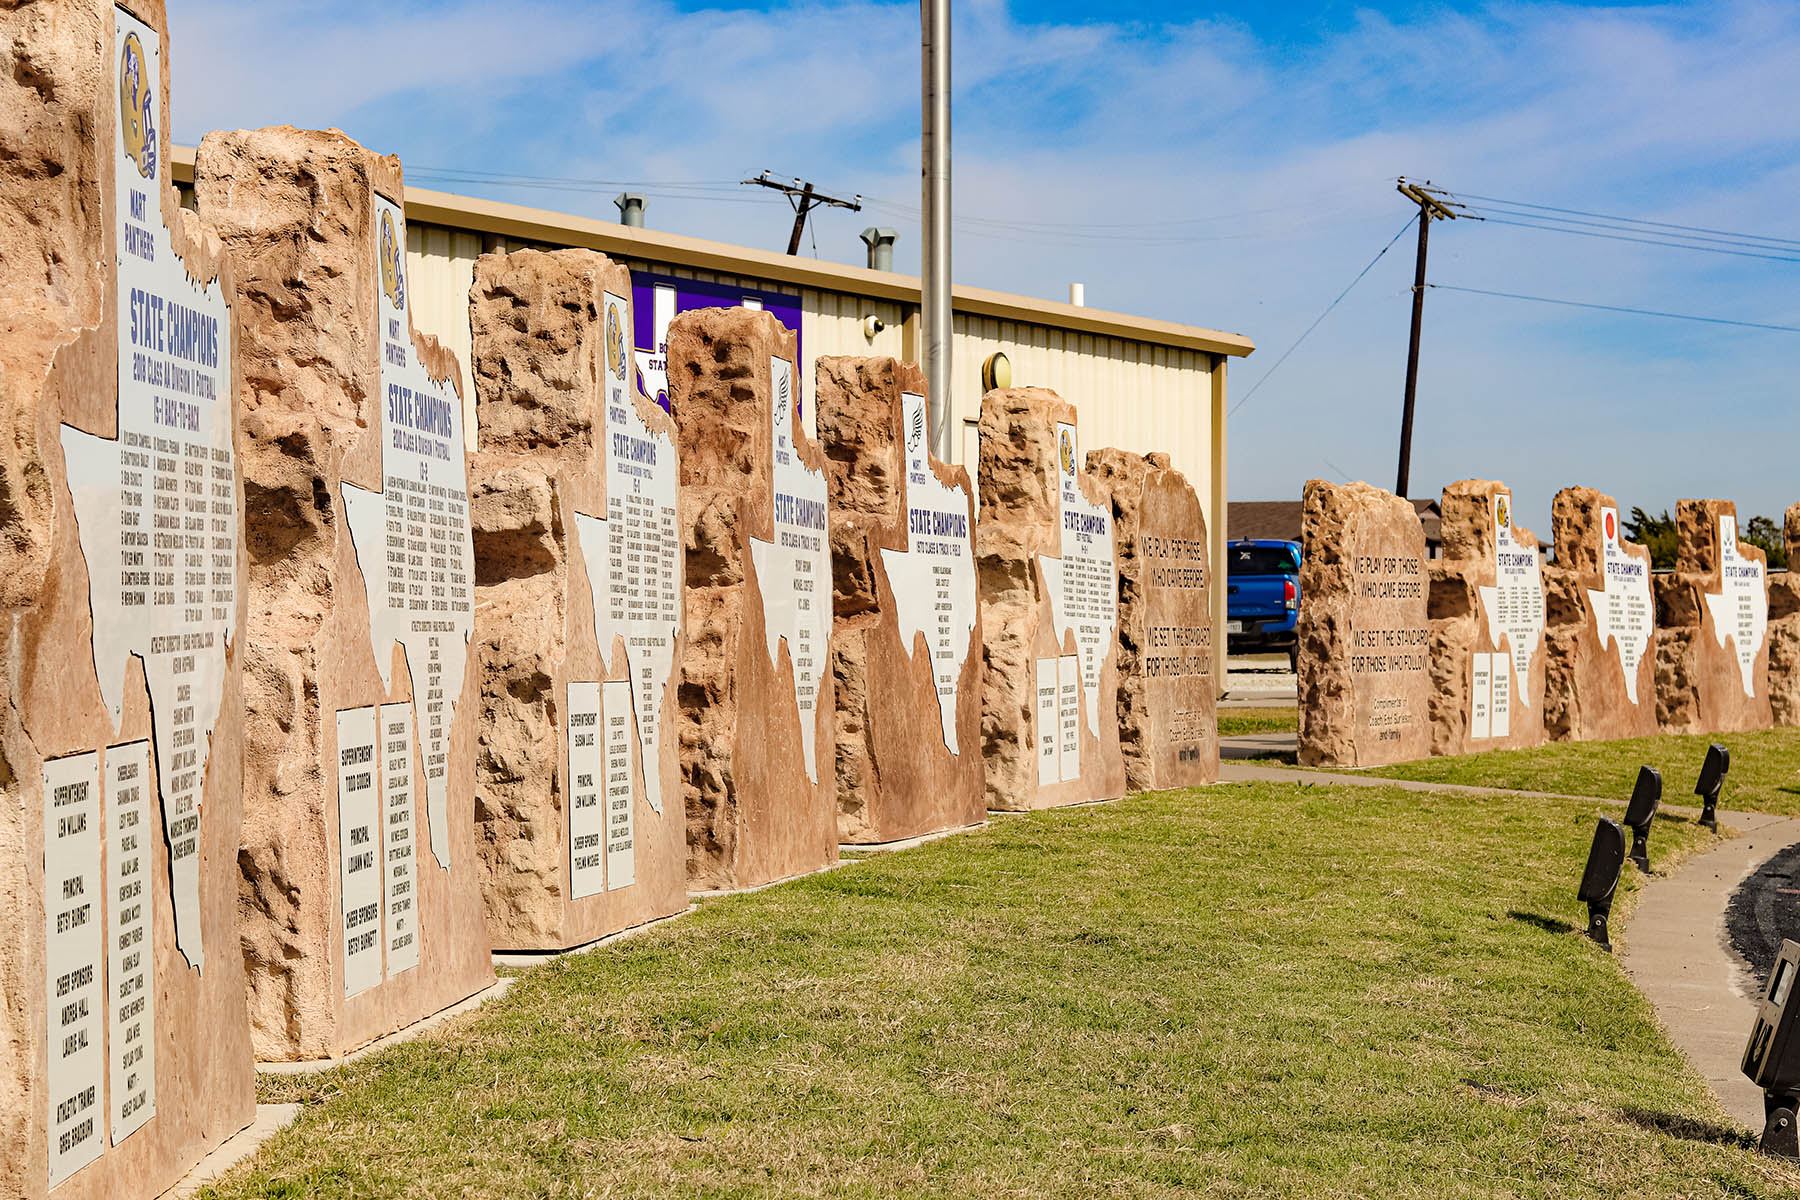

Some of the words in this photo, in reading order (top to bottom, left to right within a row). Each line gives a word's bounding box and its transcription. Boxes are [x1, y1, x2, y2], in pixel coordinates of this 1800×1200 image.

[130, 188, 147, 222] MART
[124, 223, 155, 262] PANTHERS
[131, 288, 164, 352] STATE
[168, 301, 218, 368] CHAMPIONS
[386, 342, 406, 368] PANTHERS
[133, 352, 146, 383] 2018
[147, 355, 163, 387] CLASS
[172, 360, 191, 395] DIVISION
[196, 366, 217, 400] FOOTBALL
[388, 383, 413, 428] STATE
[414, 390, 453, 438] CHAMPIONS
[403, 432, 415, 453] CLASS
[613, 432, 629, 460] STATE
[630, 437, 657, 466] CHAMPIONS
[776, 492, 794, 525] STATE
[795, 496, 826, 532] CHAMPIONS
[910, 508, 931, 535] STATE
[932, 511, 967, 539] CHAMPIONS
[1064, 510, 1080, 532] STATE
[1081, 514, 1106, 535] CHAMPIONS
[1141, 536, 1153, 557] WE
[1353, 557, 1365, 574] WE
[1366, 557, 1381, 575] PLAY
[1383, 557, 1397, 575] FOR
[1398, 557, 1419, 575] THOSE
[1498, 554, 1511, 566] STATE
[1512, 555, 1533, 568] CHAMPIONS
[1607, 562, 1620, 574] STATE
[1621, 563, 1642, 577] CHAMPIONS
[1725, 566, 1737, 577] STATE
[1738, 567, 1759, 579] CHAMPIONS
[1183, 568, 1204, 588] BEFORE
[1361, 581, 1377, 599] WHO
[1379, 582, 1396, 598] CAME
[1397, 582, 1421, 598] BEFORE
[1354, 630, 1365, 648] WE
[1367, 630, 1380, 647] SET
[1382, 630, 1395, 647] THE
[1397, 629, 1429, 646] STANDARD
[1146, 656, 1161, 677] FOR
[1352, 656, 1366, 673] FOR
[1366, 656, 1387, 673] THOSE
[1388, 655, 1403, 671] WHO
[1404, 655, 1428, 671] FOLLOW
[341, 745, 373, 766] SUPERINTENDENT
[54, 781, 89, 807] SUPERINTENDENT
[67, 812, 87, 837] WILLIAMS
[350, 825, 369, 846] PRINCIPAL
[63, 875, 84, 900] PRINCIPAL
[57, 910, 71, 934] BETSY
[72, 903, 91, 928] BURNETT
[346, 909, 358, 930] CHEER
[57, 973, 70, 998] CHEER
[71, 963, 93, 991] SPONSORS
[57, 1096, 77, 1125] ATHLETIC
[78, 1085, 95, 1113] TRAINER
